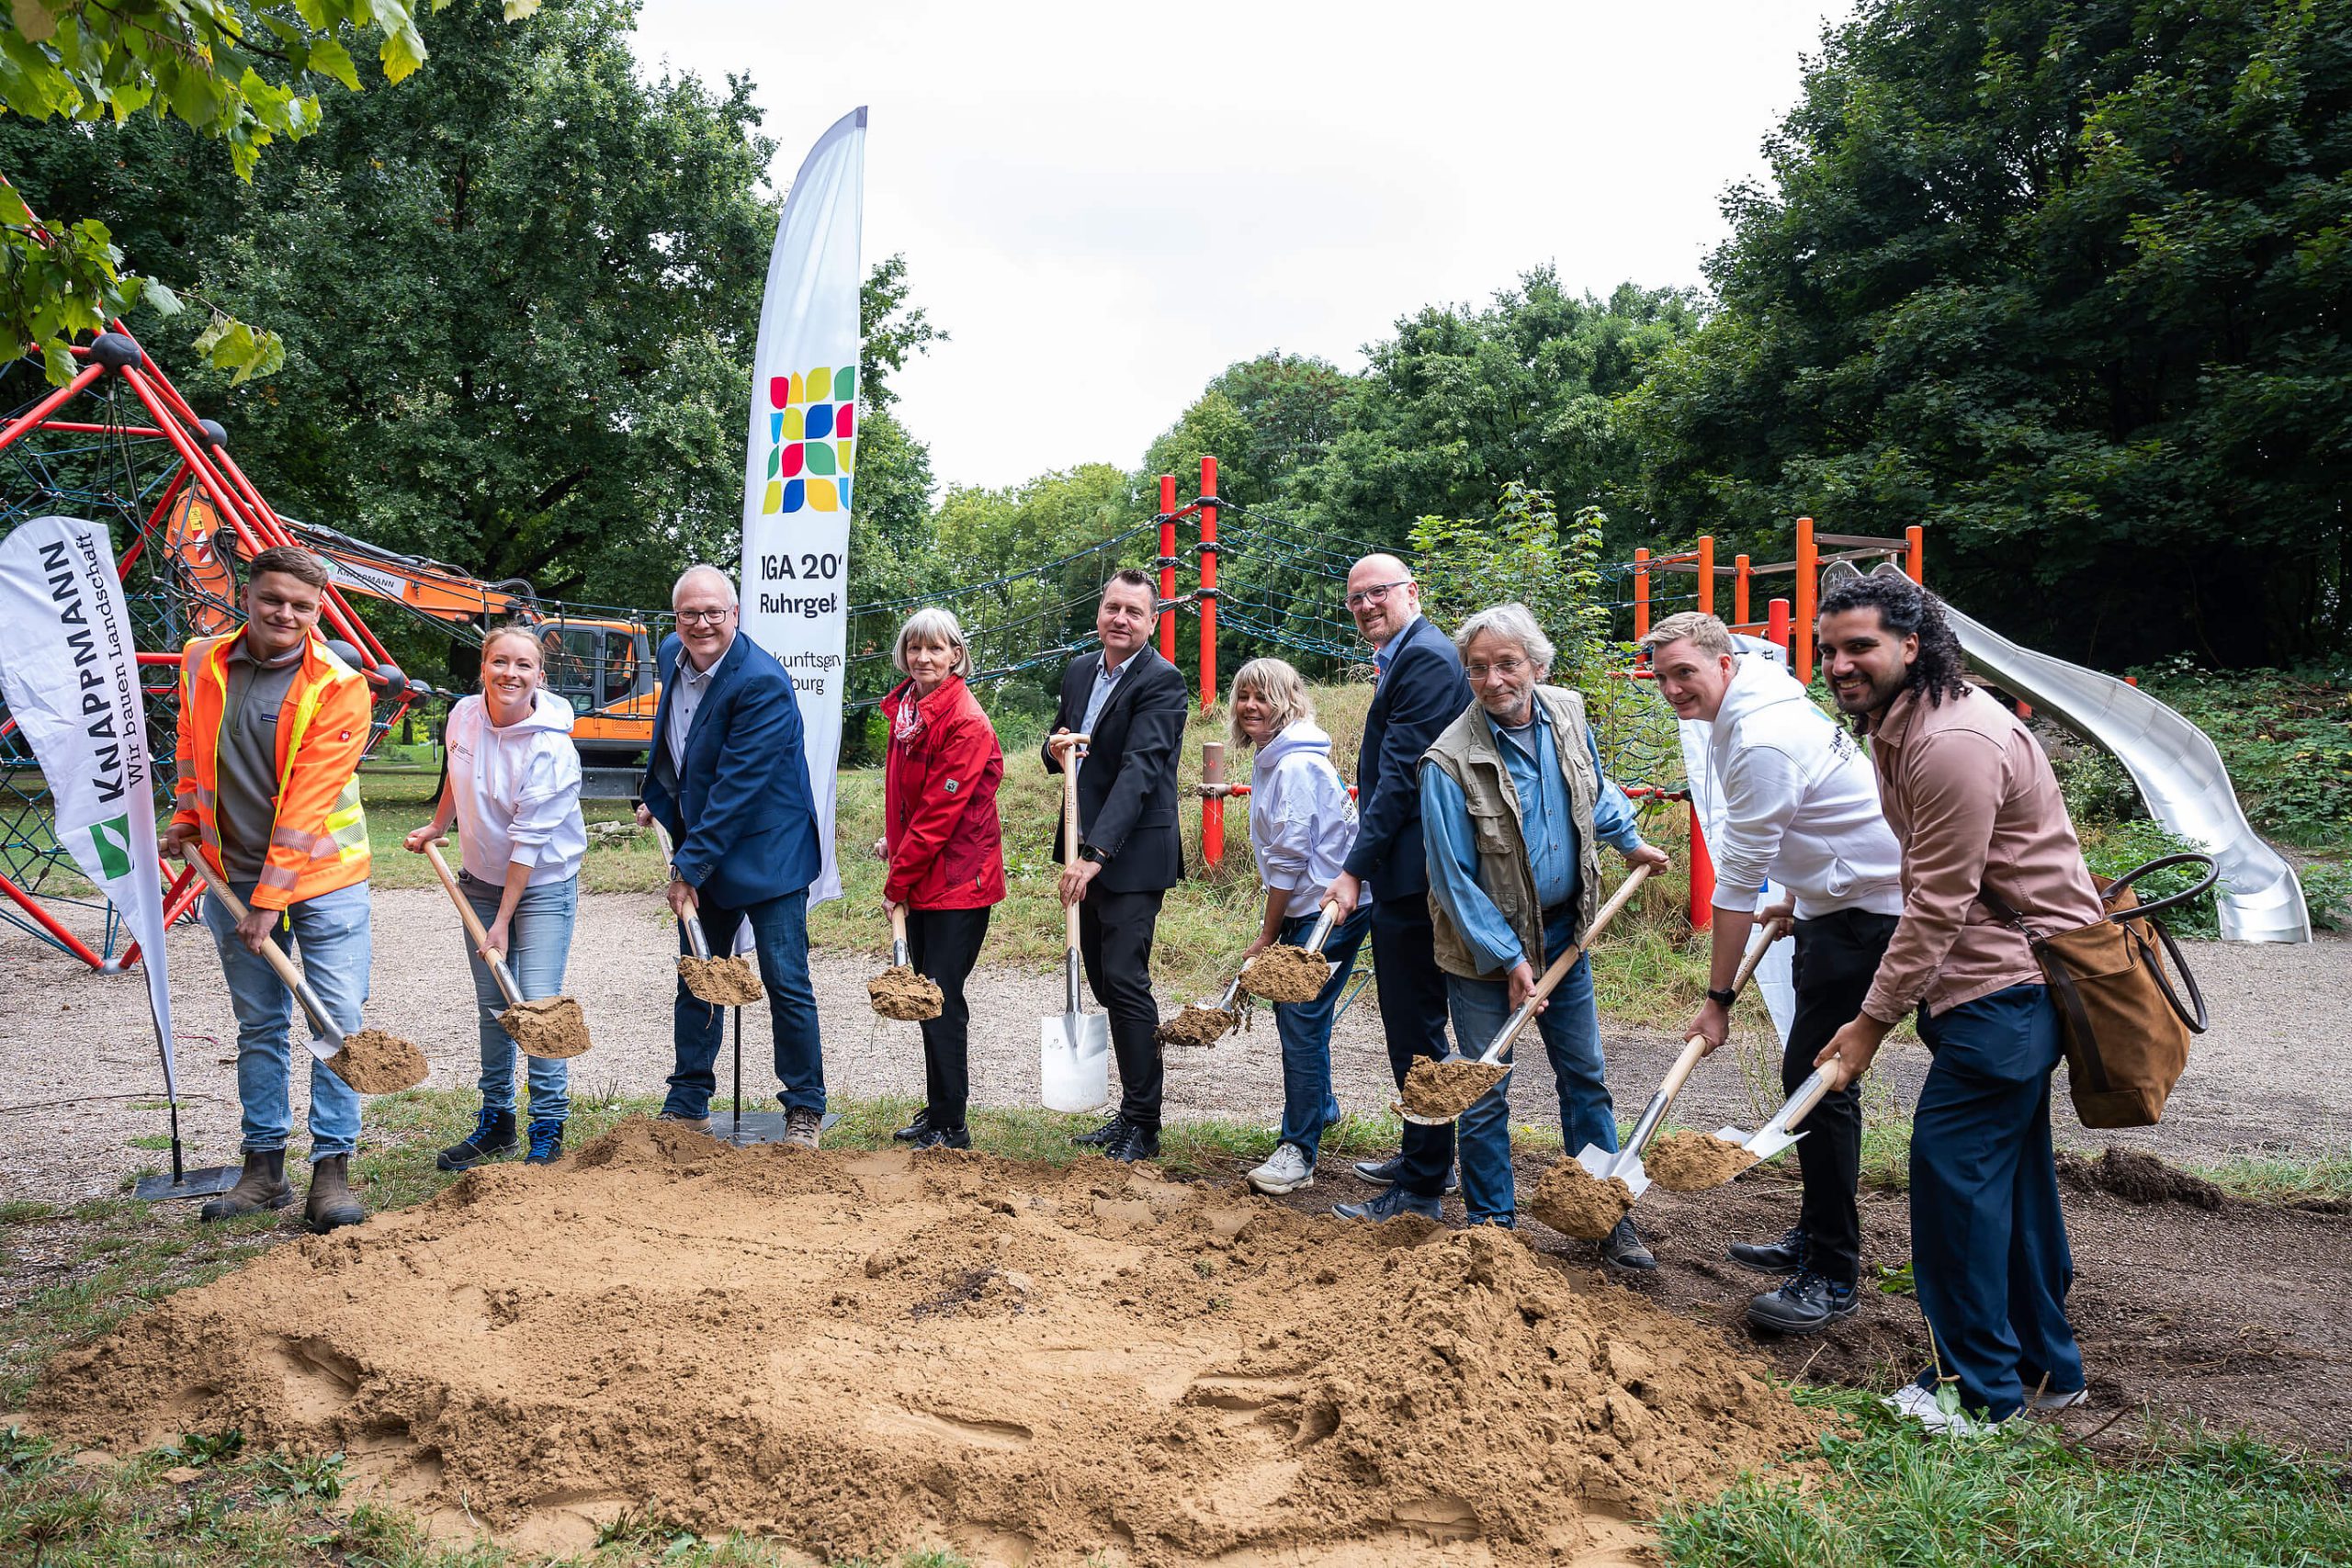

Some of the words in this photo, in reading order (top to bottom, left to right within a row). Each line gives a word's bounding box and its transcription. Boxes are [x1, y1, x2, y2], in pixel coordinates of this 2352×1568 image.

[76, 532, 123, 660] Landschaft
[761, 554, 797, 581] IGA
[801, 553, 842, 580] 20
[39, 540, 126, 804] KNAPPMANN
[115, 662, 138, 739] bauen
[126, 743, 145, 789] Wir
